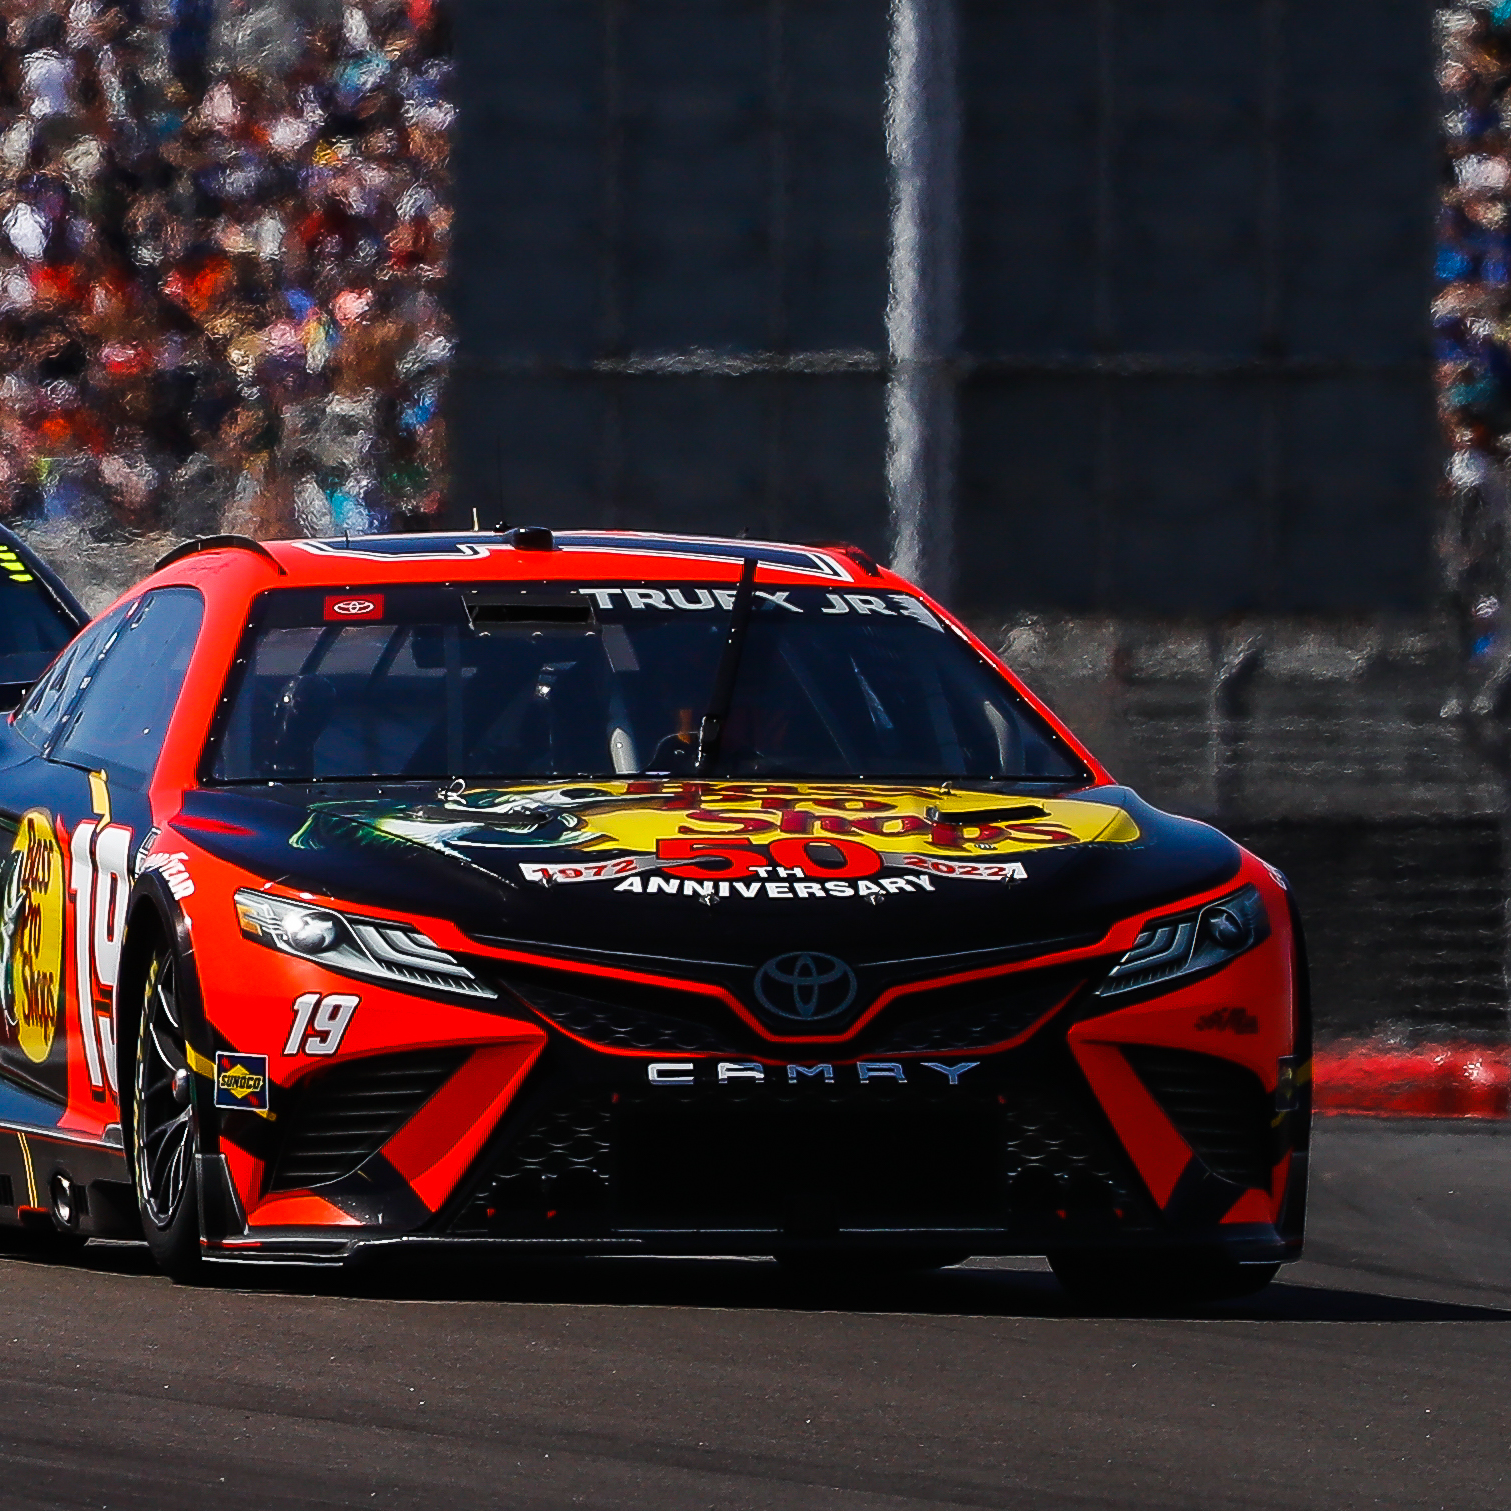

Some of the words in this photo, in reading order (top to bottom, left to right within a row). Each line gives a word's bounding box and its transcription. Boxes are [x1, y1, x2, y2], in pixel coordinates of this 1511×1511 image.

[656, 837, 883, 880] 50
[748, 865, 806, 879] TH
[612, 874, 937, 899] ANNIVERSARY
[283, 992, 362, 1055] 19
[219, 1074, 264, 1091] SUNOCO
[647, 1061, 981, 1086] CAMRY
